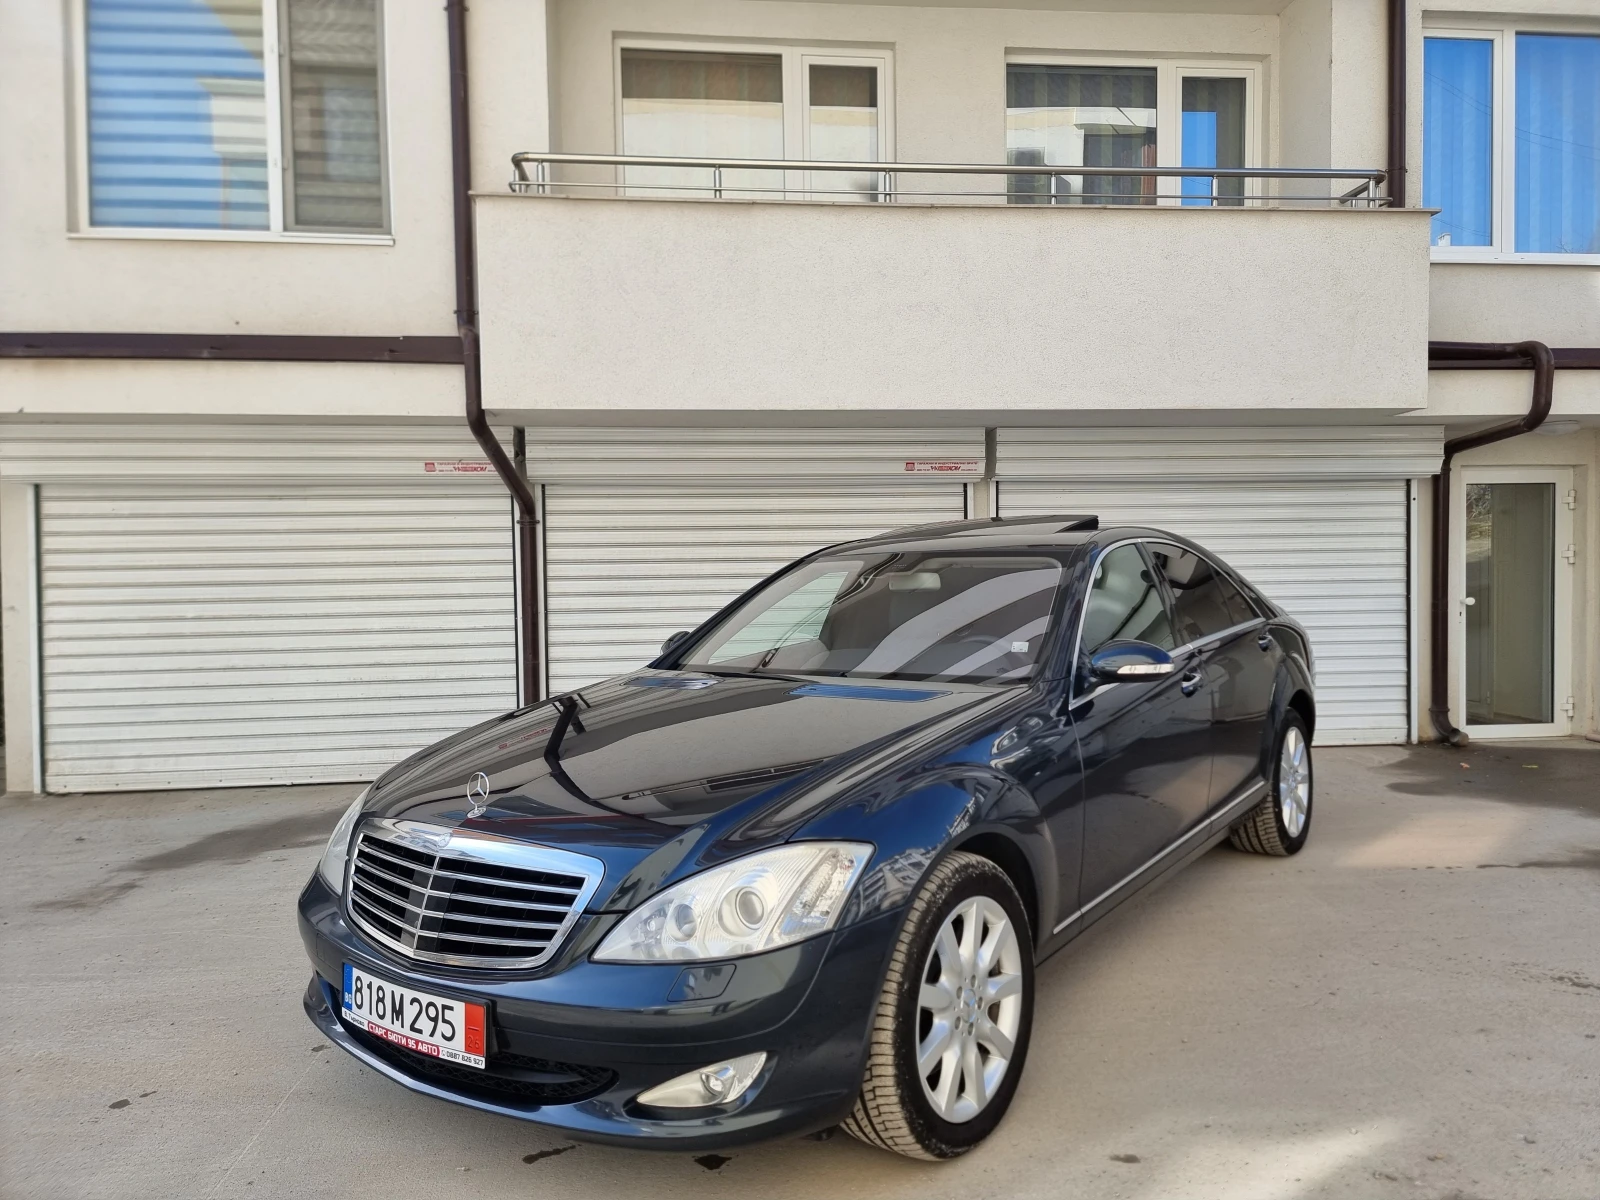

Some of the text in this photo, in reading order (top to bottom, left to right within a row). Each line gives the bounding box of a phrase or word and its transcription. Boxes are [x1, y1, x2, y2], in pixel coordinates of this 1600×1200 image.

[368, 1023, 438, 1055] СТАРС БЮТИ 95 АВТО
